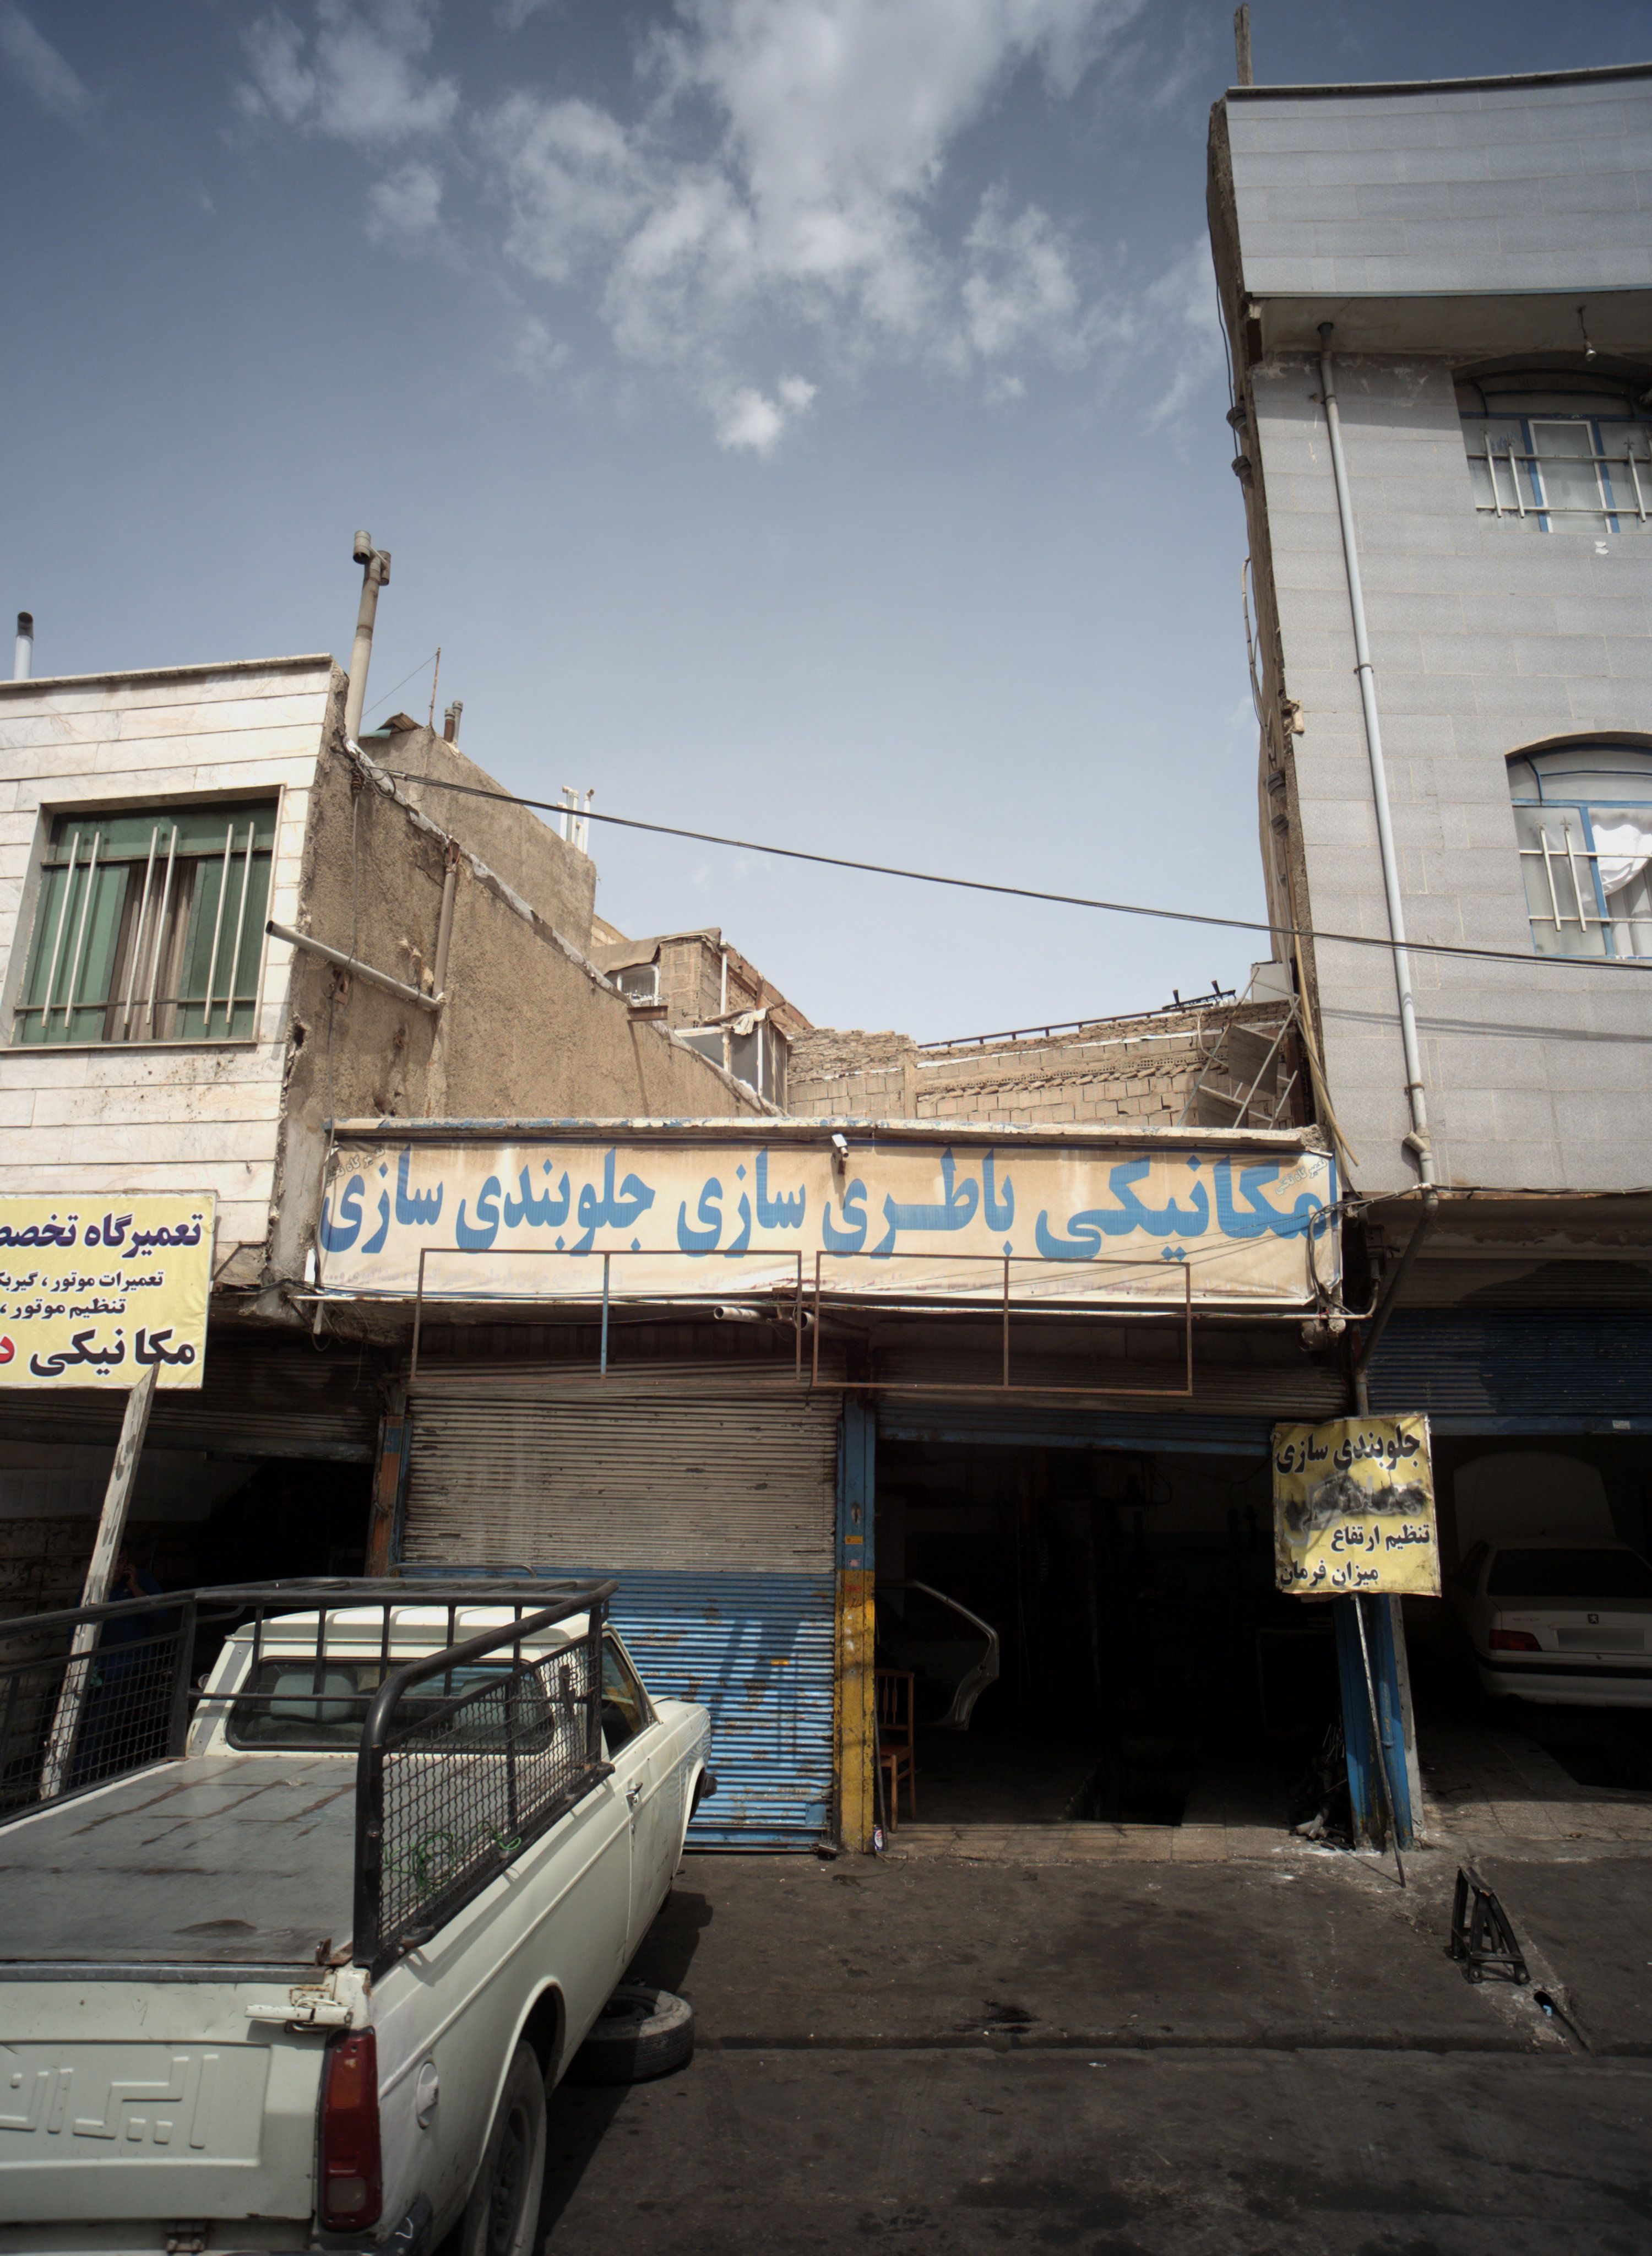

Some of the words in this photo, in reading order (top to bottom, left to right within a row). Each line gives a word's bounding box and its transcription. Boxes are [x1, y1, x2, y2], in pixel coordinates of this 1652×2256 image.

[320, 1144, 443, 1254] سازی
[455, 1146, 656, 1257] جلوبندی
[677, 1146, 806, 1258] سازی
[822, 1147, 1015, 1259] باطری
[1035, 1155, 1327, 1262] مکانیکی
[84, 1212, 203, 1259] تعمیرگاه
[99, 1271, 164, 1292] تعمیرات
[69, 1298, 127, 1319] تنظیم
[30, 1327, 195, 1378] مکانیکی
[1275, 1433, 1328, 1474] سازی
[1333, 1424, 1421, 1471] جلوبندی
[1330, 1525, 1380, 1552] ارتفاع
[1385, 1523, 1430, 1551] تنظیم
[1280, 1560, 1327, 1586] فرمان
[1332, 1561, 1379, 1586] میزان
